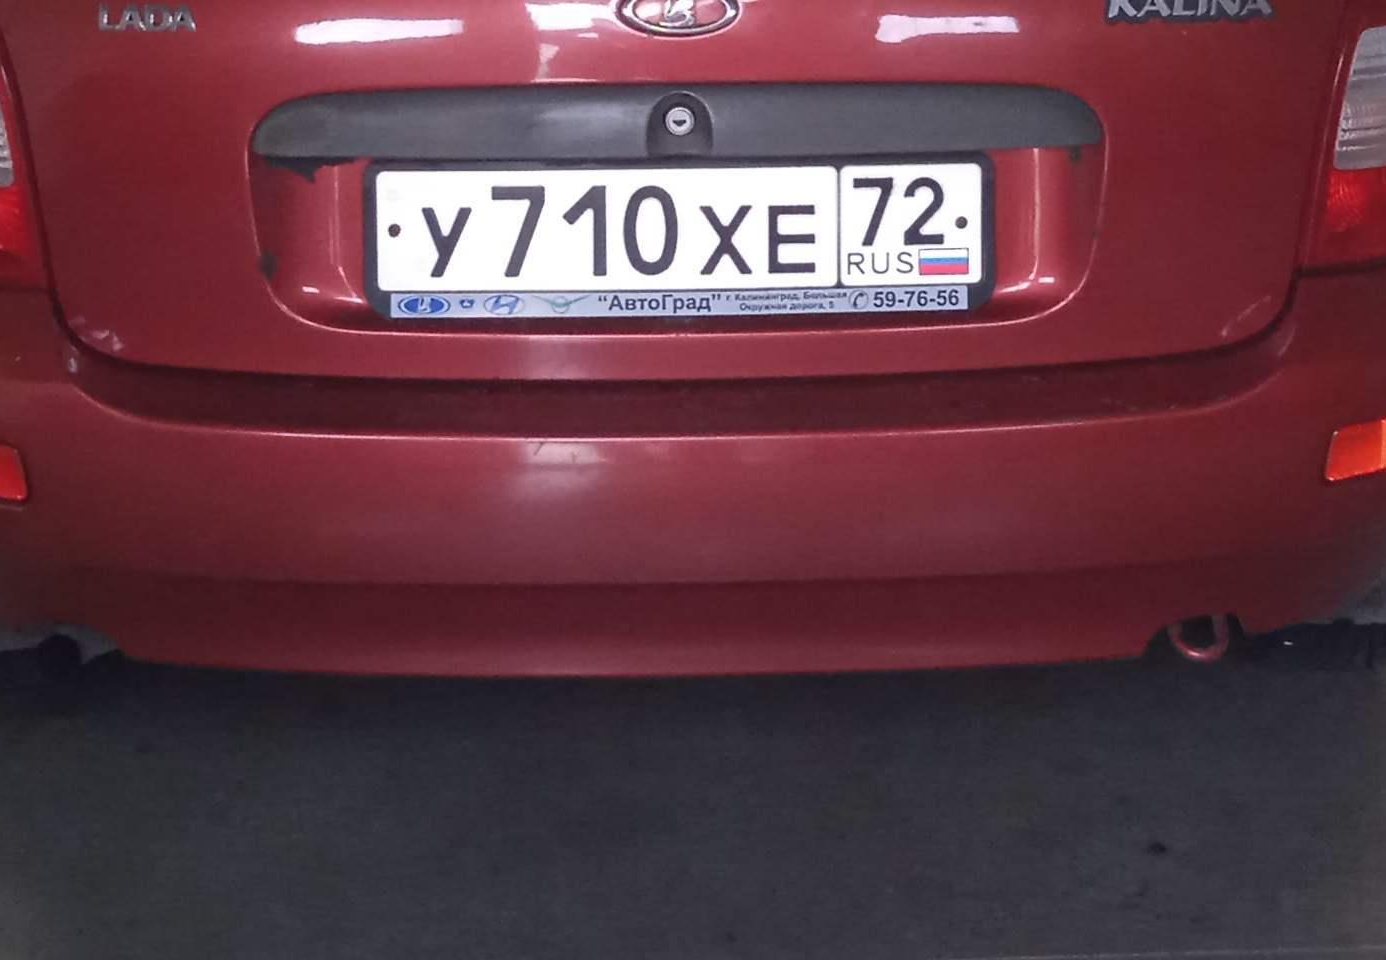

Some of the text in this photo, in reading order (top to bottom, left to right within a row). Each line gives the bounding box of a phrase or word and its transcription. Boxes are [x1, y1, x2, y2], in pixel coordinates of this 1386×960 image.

[99, 2, 197, 32] LADA
[853, 177, 945, 247] 72
[848, 251, 914, 275] RUS
[873, 289, 960, 309] 59-76-56
